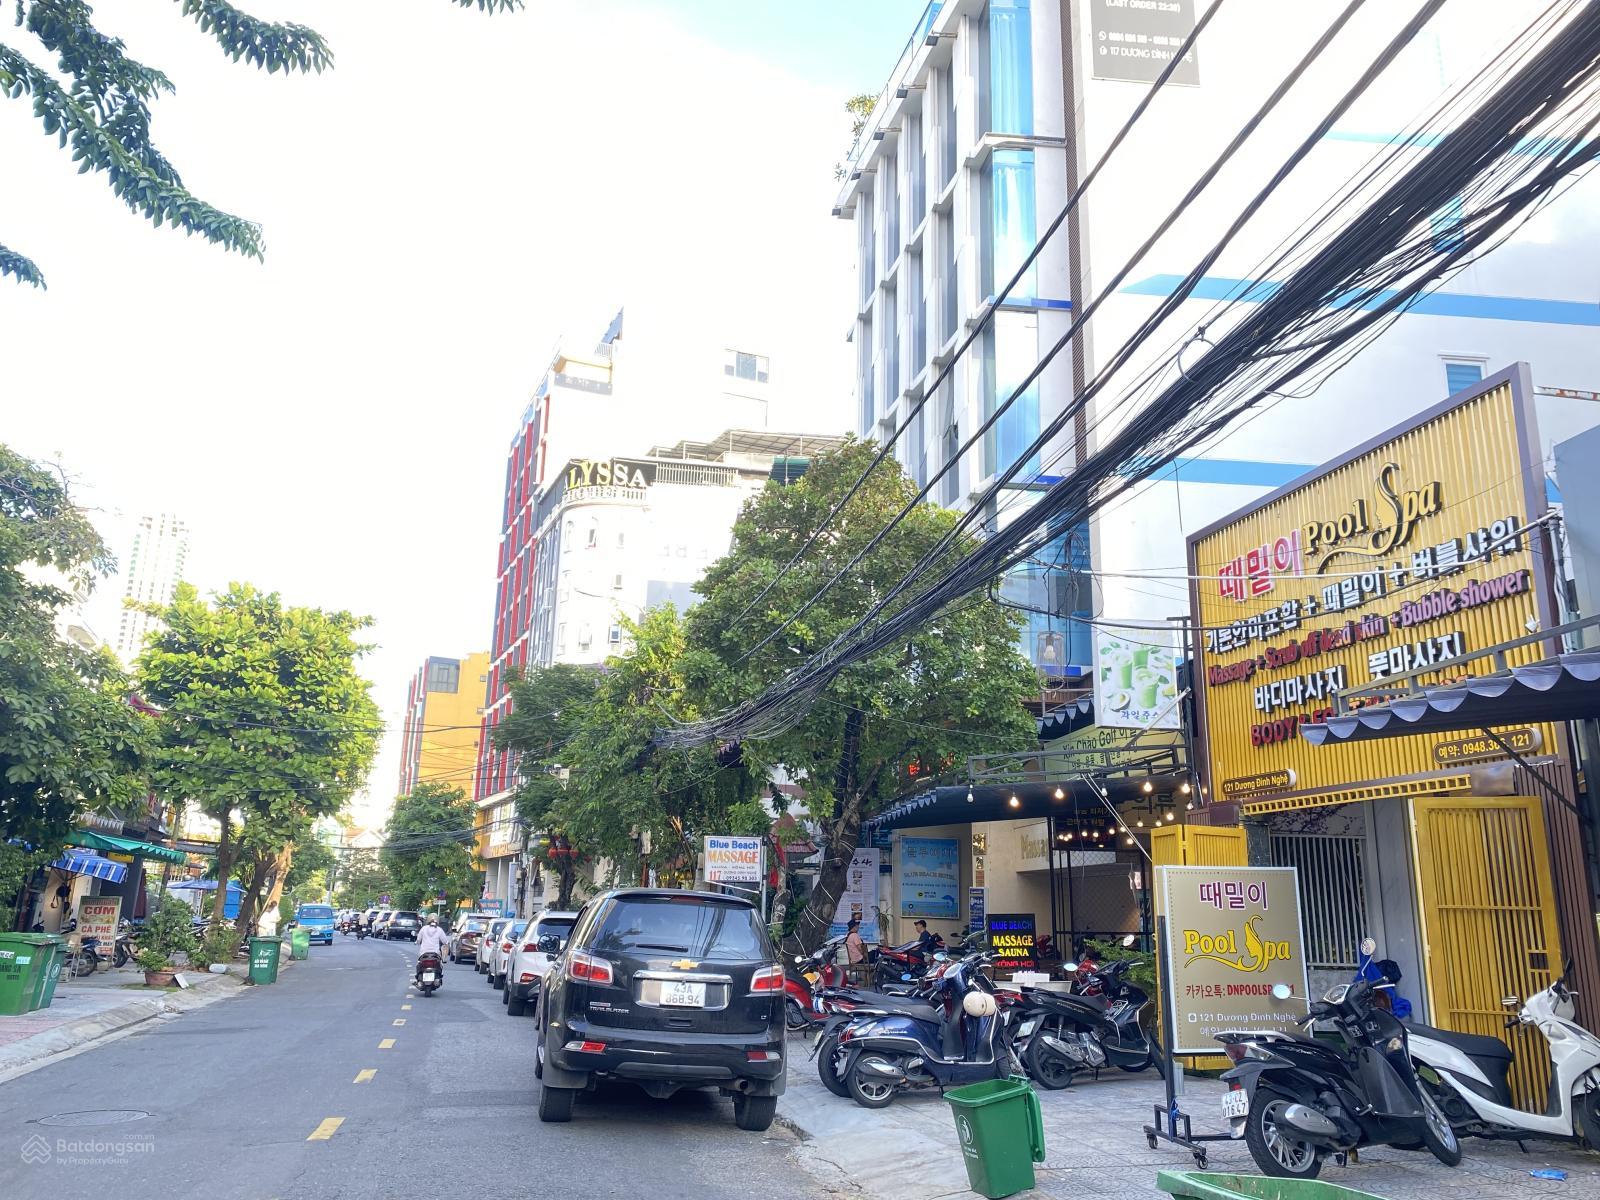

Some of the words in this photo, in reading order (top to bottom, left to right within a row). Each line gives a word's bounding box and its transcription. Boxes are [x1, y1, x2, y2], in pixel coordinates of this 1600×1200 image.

[567, 460, 647, 489] LYSSA
[1302, 499, 1369, 555] Pool
[1374, 462, 1442, 556] Spa
[1218, 529, 1302, 602] 때밀이
[1322, 566, 1387, 611] 때밀이
[1208, 659, 1256, 687] Massage
[1264, 639, 1300, 670] Scrub
[1301, 630, 1321, 657] off
[1320, 620, 1356, 652] dead
[1400, 587, 1462, 628] Bubble
[1459, 569, 1530, 609] shower
[1254, 664, 1348, 713] 바디마사지
[1369, 631, 1466, 681] 풋마사지
[1099, 728, 1117, 747] Golf
[1251, 716, 1299, 746] BODY
[1511, 733, 1530, 747] 121
[1224, 782, 1234, 793] 121
[709, 840, 730, 849] Blue
[731, 841, 758, 849] Beach
[708, 850, 759, 864] MASSAGE
[709, 870, 722, 880] 117
[1199, 881, 1269, 910] 때밀이
[991, 921, 1008, 930] BLUE
[1009, 920, 1033, 930] BEACH
[992, 935, 1034, 947] MASSAGE
[1183, 929, 1238, 954] Pool
[1244, 914, 1292, 973] Spa
[998, 948, 1030, 957] SAUNA
[1199, 1012, 1215, 1022] 121
